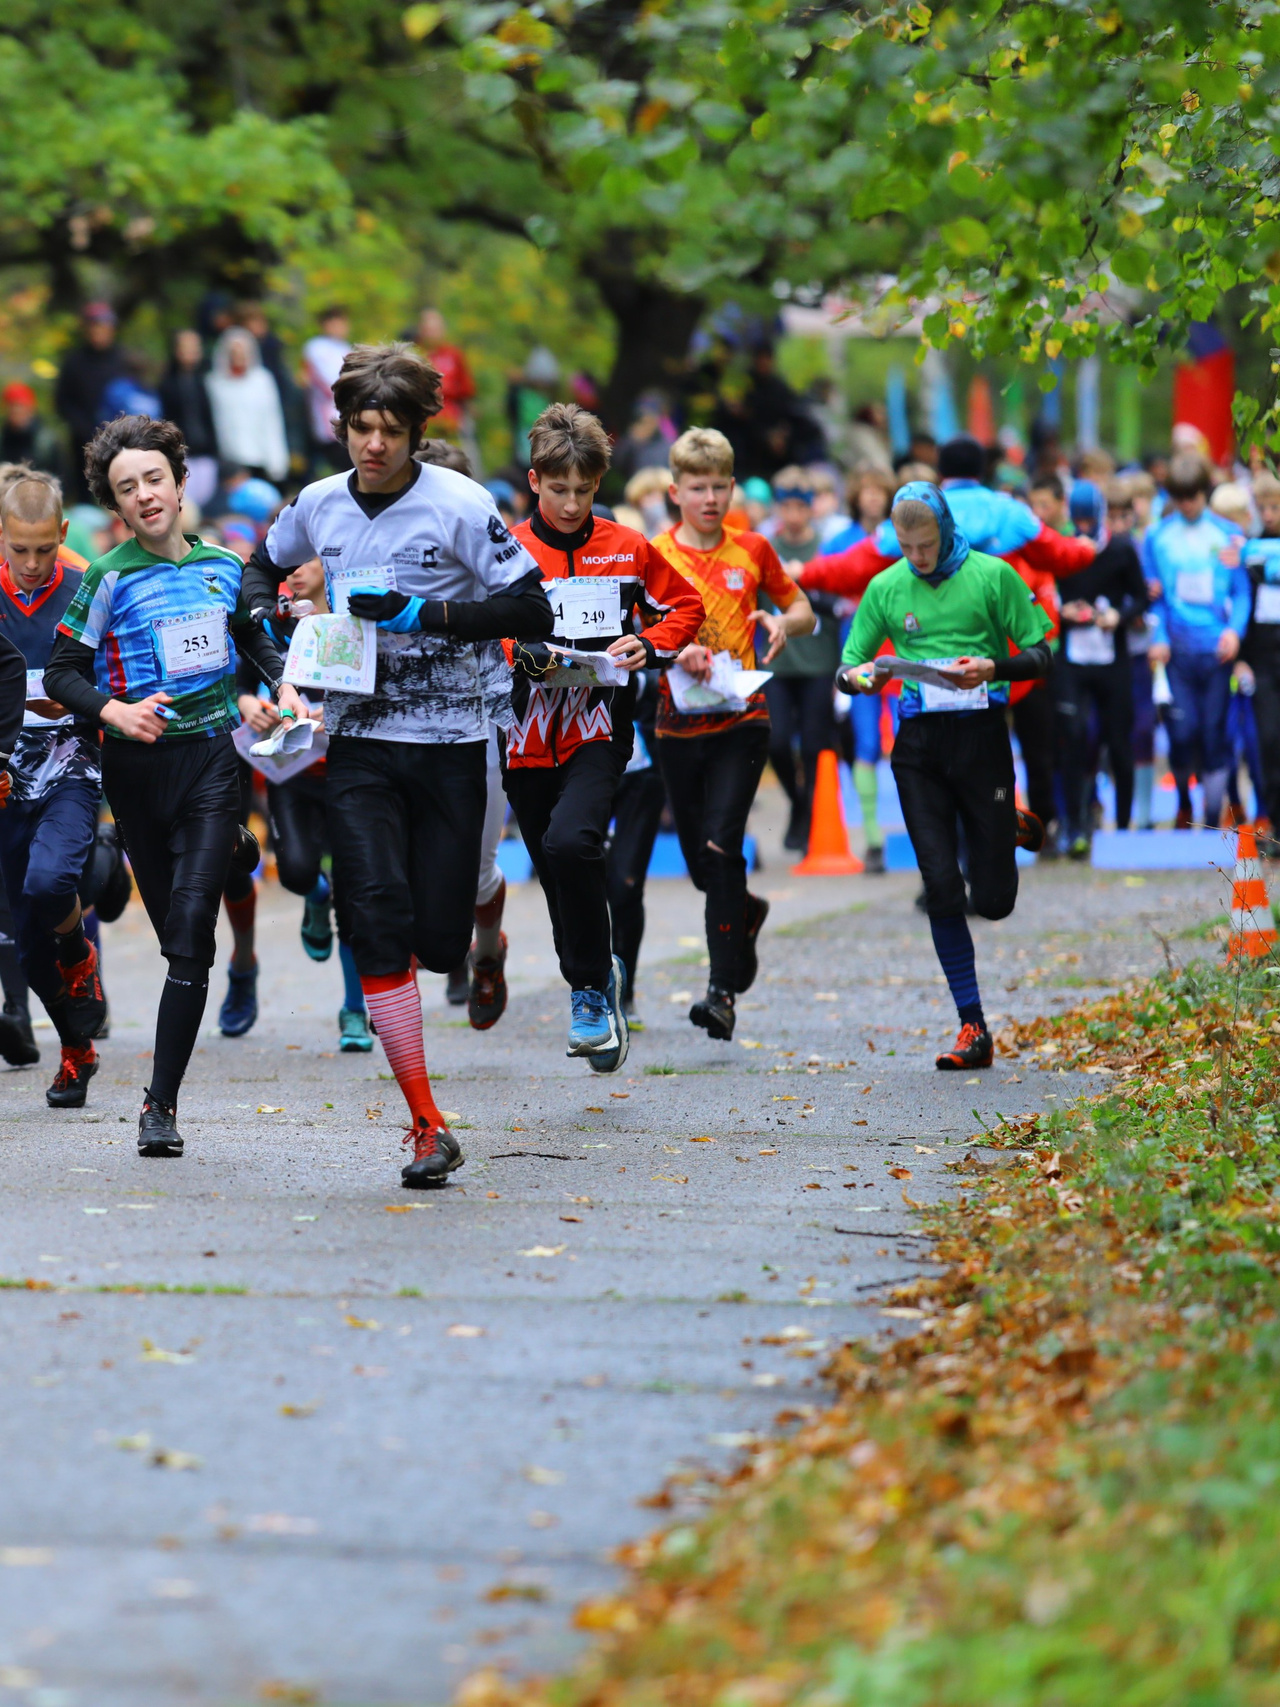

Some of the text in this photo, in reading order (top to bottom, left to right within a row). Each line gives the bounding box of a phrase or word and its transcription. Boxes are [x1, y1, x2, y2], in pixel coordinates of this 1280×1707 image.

[582, 553, 634, 565] МОСКВА
[582, 610, 605, 625] 249
[183, 635, 209, 653] 253
